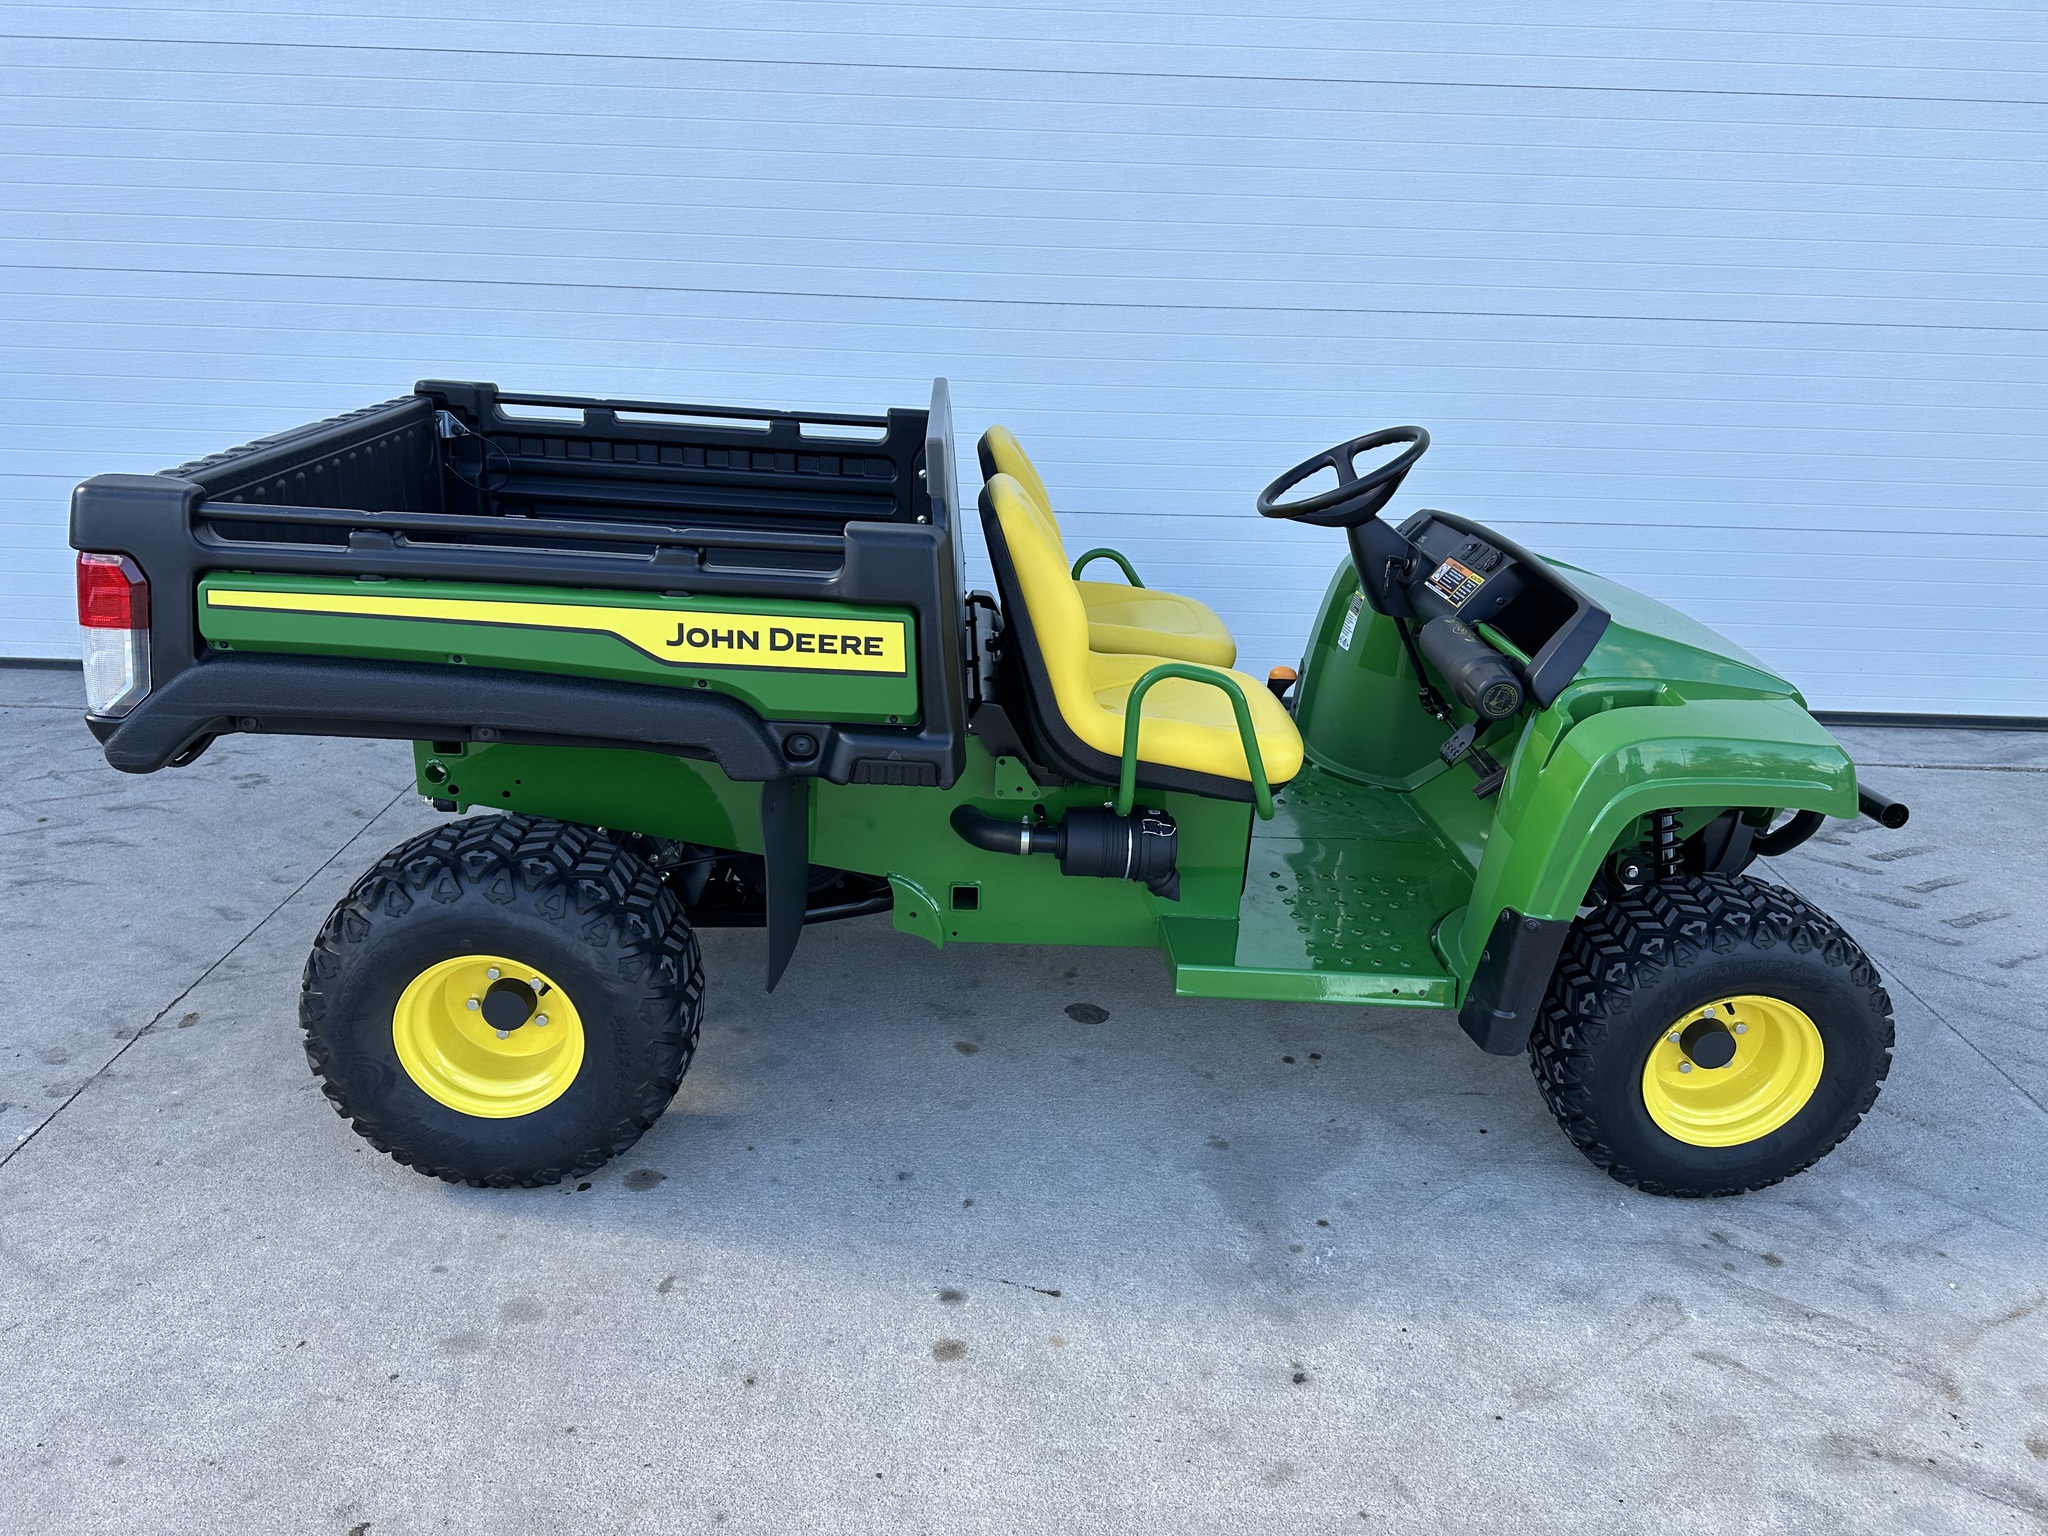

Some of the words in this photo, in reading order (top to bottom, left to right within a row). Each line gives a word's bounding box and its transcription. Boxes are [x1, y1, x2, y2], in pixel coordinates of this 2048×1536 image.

[666, 622, 759, 650] JOHN
[769, 627, 884, 656] DEERE
[1687, 959, 1808, 992] WANDA
